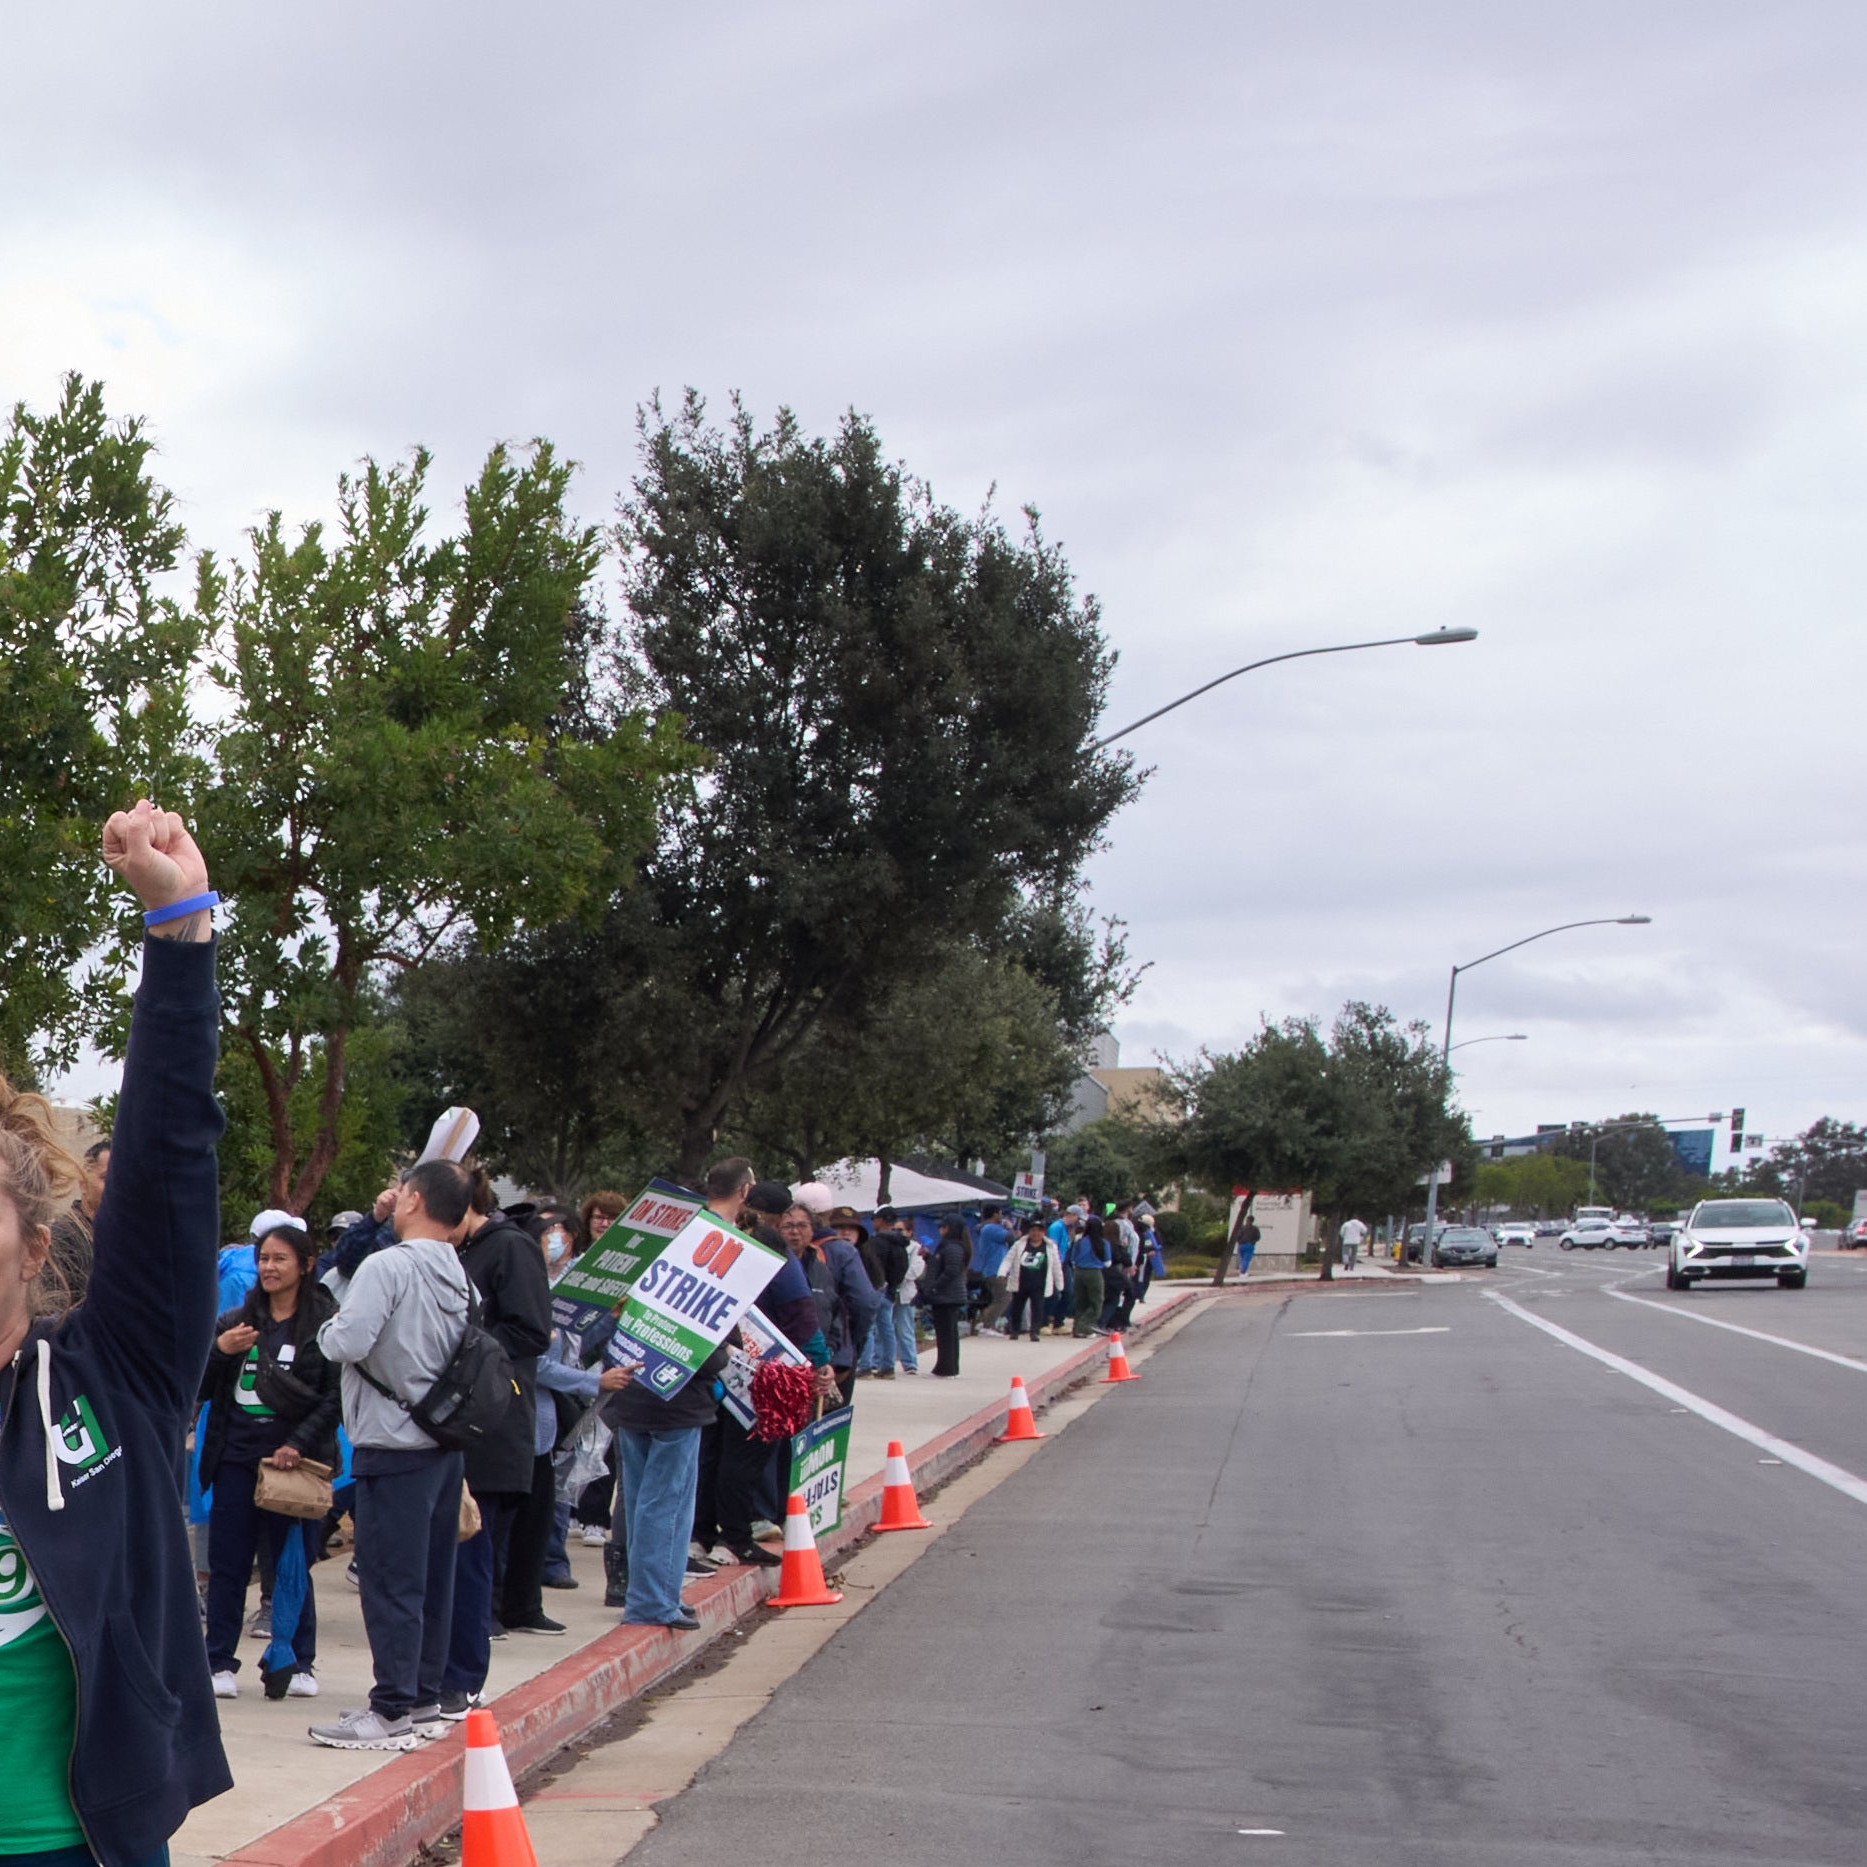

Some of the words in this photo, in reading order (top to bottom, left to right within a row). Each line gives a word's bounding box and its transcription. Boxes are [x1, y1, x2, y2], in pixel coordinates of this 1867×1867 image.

[629, 1199, 657, 1221] ON
[648, 1203, 693, 1231] STRIKE
[592, 1249, 641, 1275] PATIENT
[692, 1230, 744, 1280] ON
[639, 1259, 739, 1333] STRIKE
[630, 1318, 693, 1362] Professions
[88, 1464, 105, 1476] San
